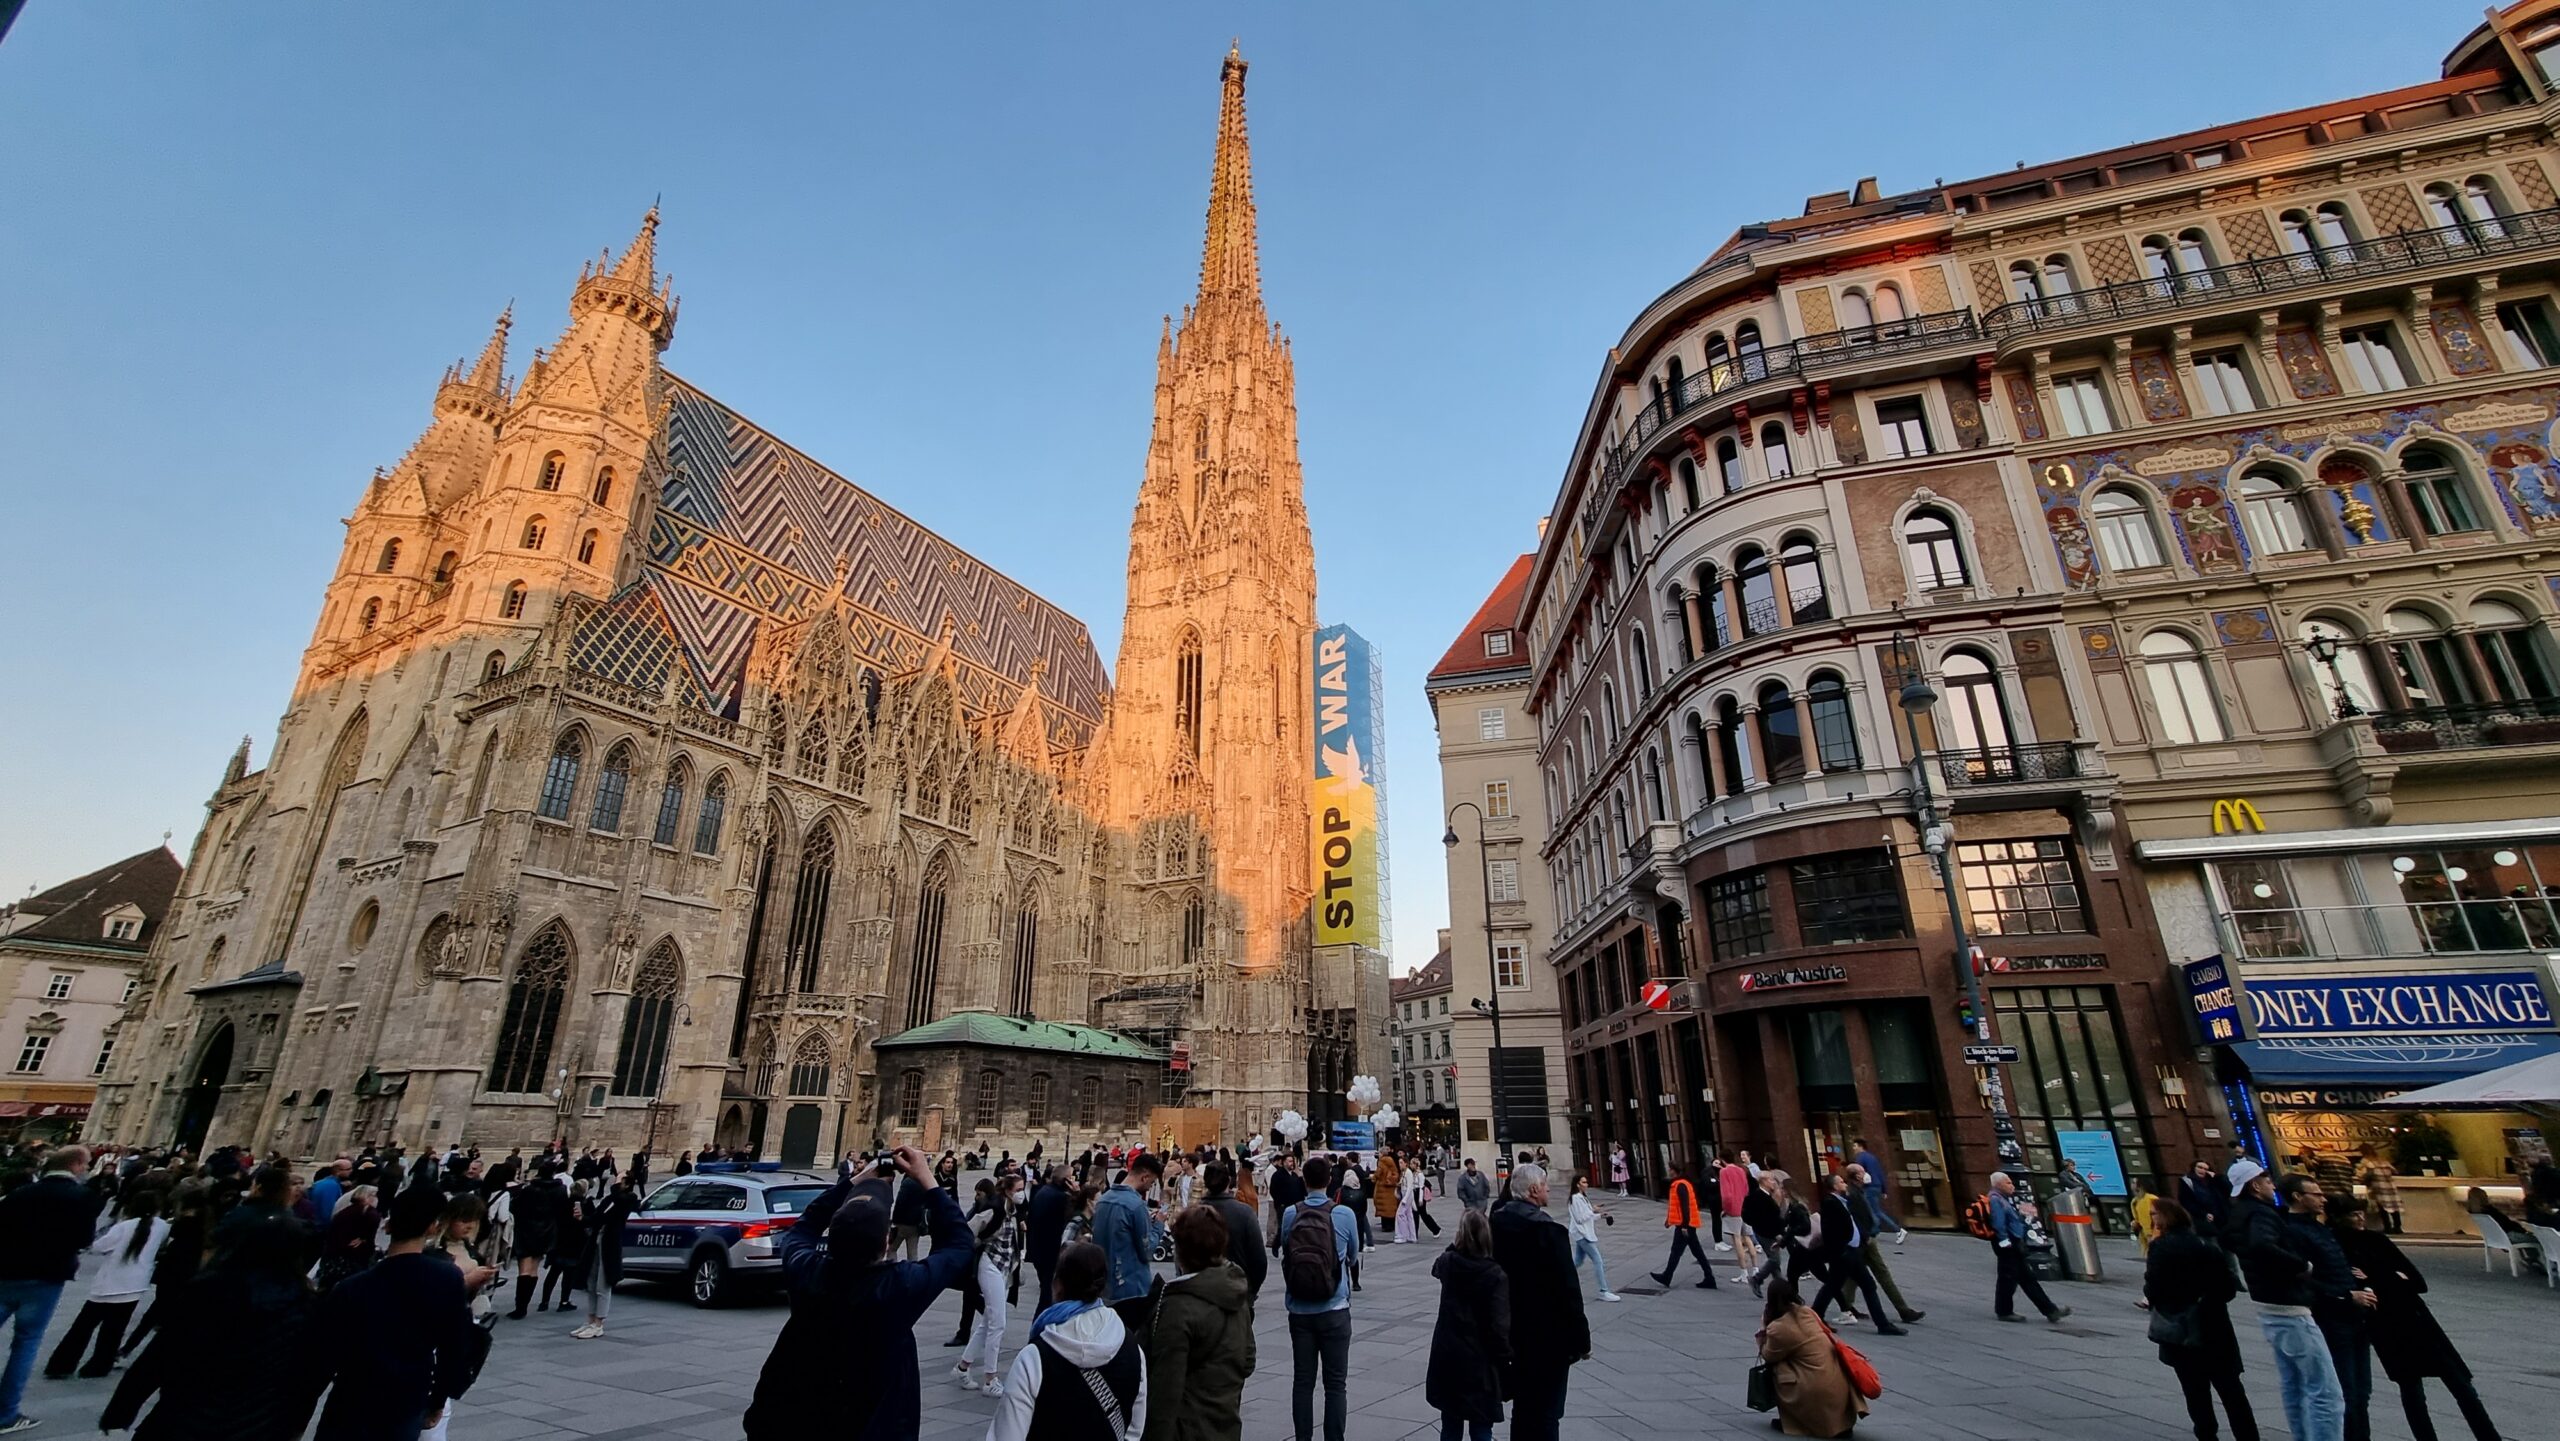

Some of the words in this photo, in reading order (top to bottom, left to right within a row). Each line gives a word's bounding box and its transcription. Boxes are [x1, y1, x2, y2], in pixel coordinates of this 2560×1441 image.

[1320, 633, 1348, 735] WAR
[1323, 806, 1354, 929] STOP
[1754, 968, 1789, 987] Bank
[1793, 964, 1846, 983] Austria
[2191, 964, 2222, 986] CAMBIO
[2194, 986, 2235, 1014] CHANGE
[2245, 988, 2334, 1027] ONEY
[2339, 983, 2551, 1026] EXCHANGE
[2308, 1036, 2429, 1047] CHANGE
[2260, 1090, 2318, 1105] ONEY
[2324, 1090, 2400, 1105] CHANG
[2273, 1127, 2290, 1138] HE
[2295, 1126, 2353, 1138] CHANGE
[732, 1199, 746, 1209] 133
[637, 1233, 675, 1246] POLIZEI
